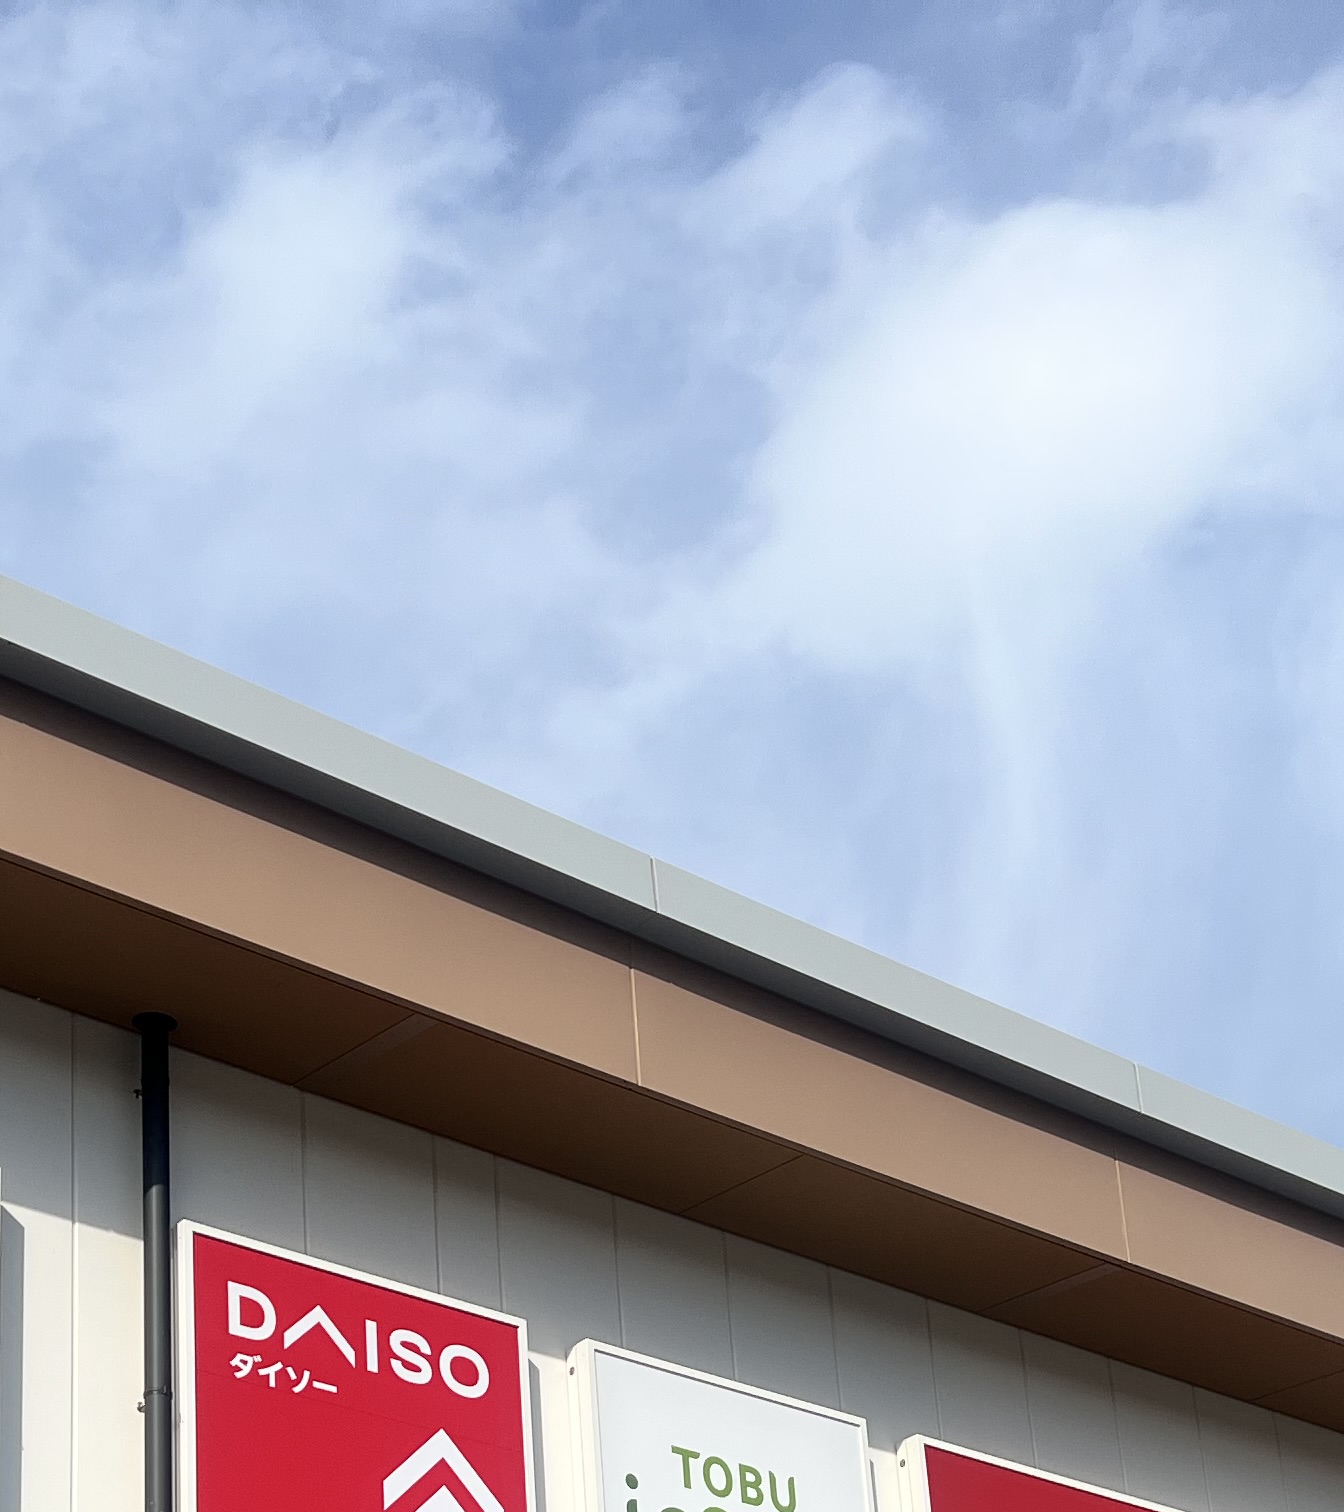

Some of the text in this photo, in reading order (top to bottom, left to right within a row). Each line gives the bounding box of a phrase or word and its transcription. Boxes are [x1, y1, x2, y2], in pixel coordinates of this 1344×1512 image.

[226, 1280, 491, 1399] DAISO
[228, 1351, 338, 1394] ダイソー
